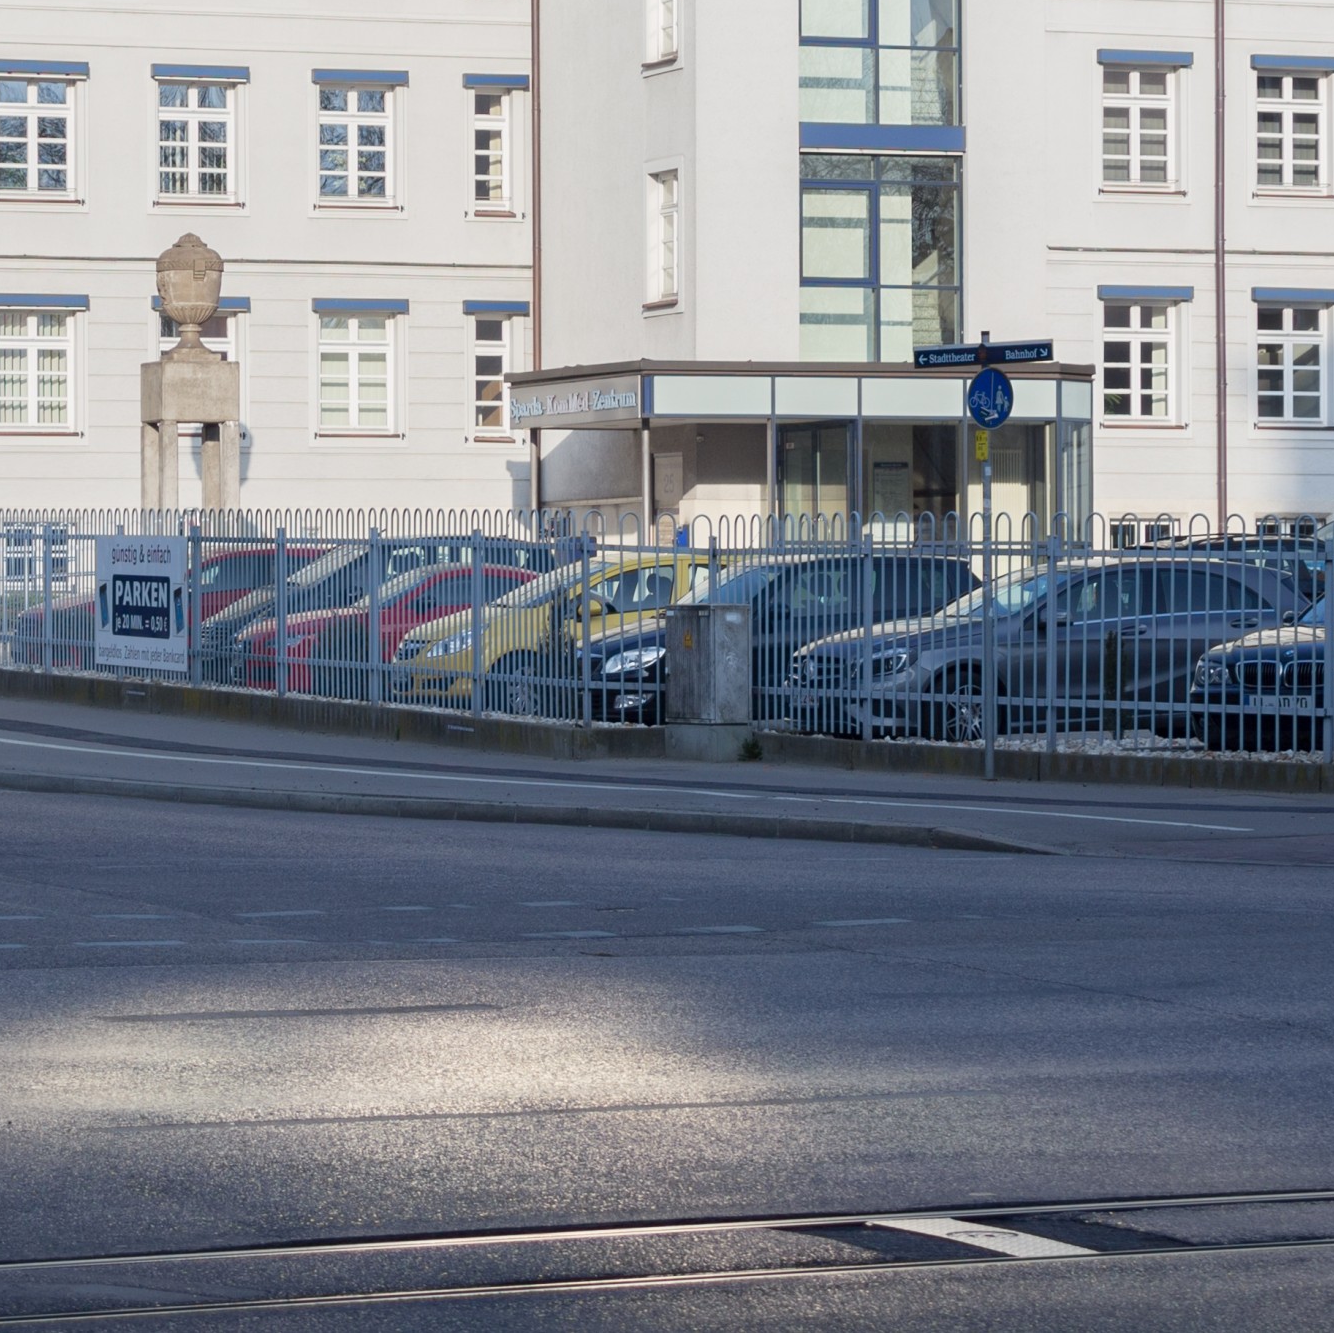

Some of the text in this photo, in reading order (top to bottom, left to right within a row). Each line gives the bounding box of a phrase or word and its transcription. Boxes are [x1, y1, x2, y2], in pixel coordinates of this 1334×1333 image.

[929, 353, 975, 364] Stadttheater
[1005, 348, 1038, 360] Bahnhof
[112, 544, 171, 565] günstig & einfach
[115, 580, 168, 608] PARKEN
[115, 613, 168, 633] je 20 MIN. = 0,50 €
[124, 645, 140, 660] Zahlen
[141, 647, 149, 661] mit
[150, 646, 163, 665] jeder
[163, 648, 185, 664] Bankcard
